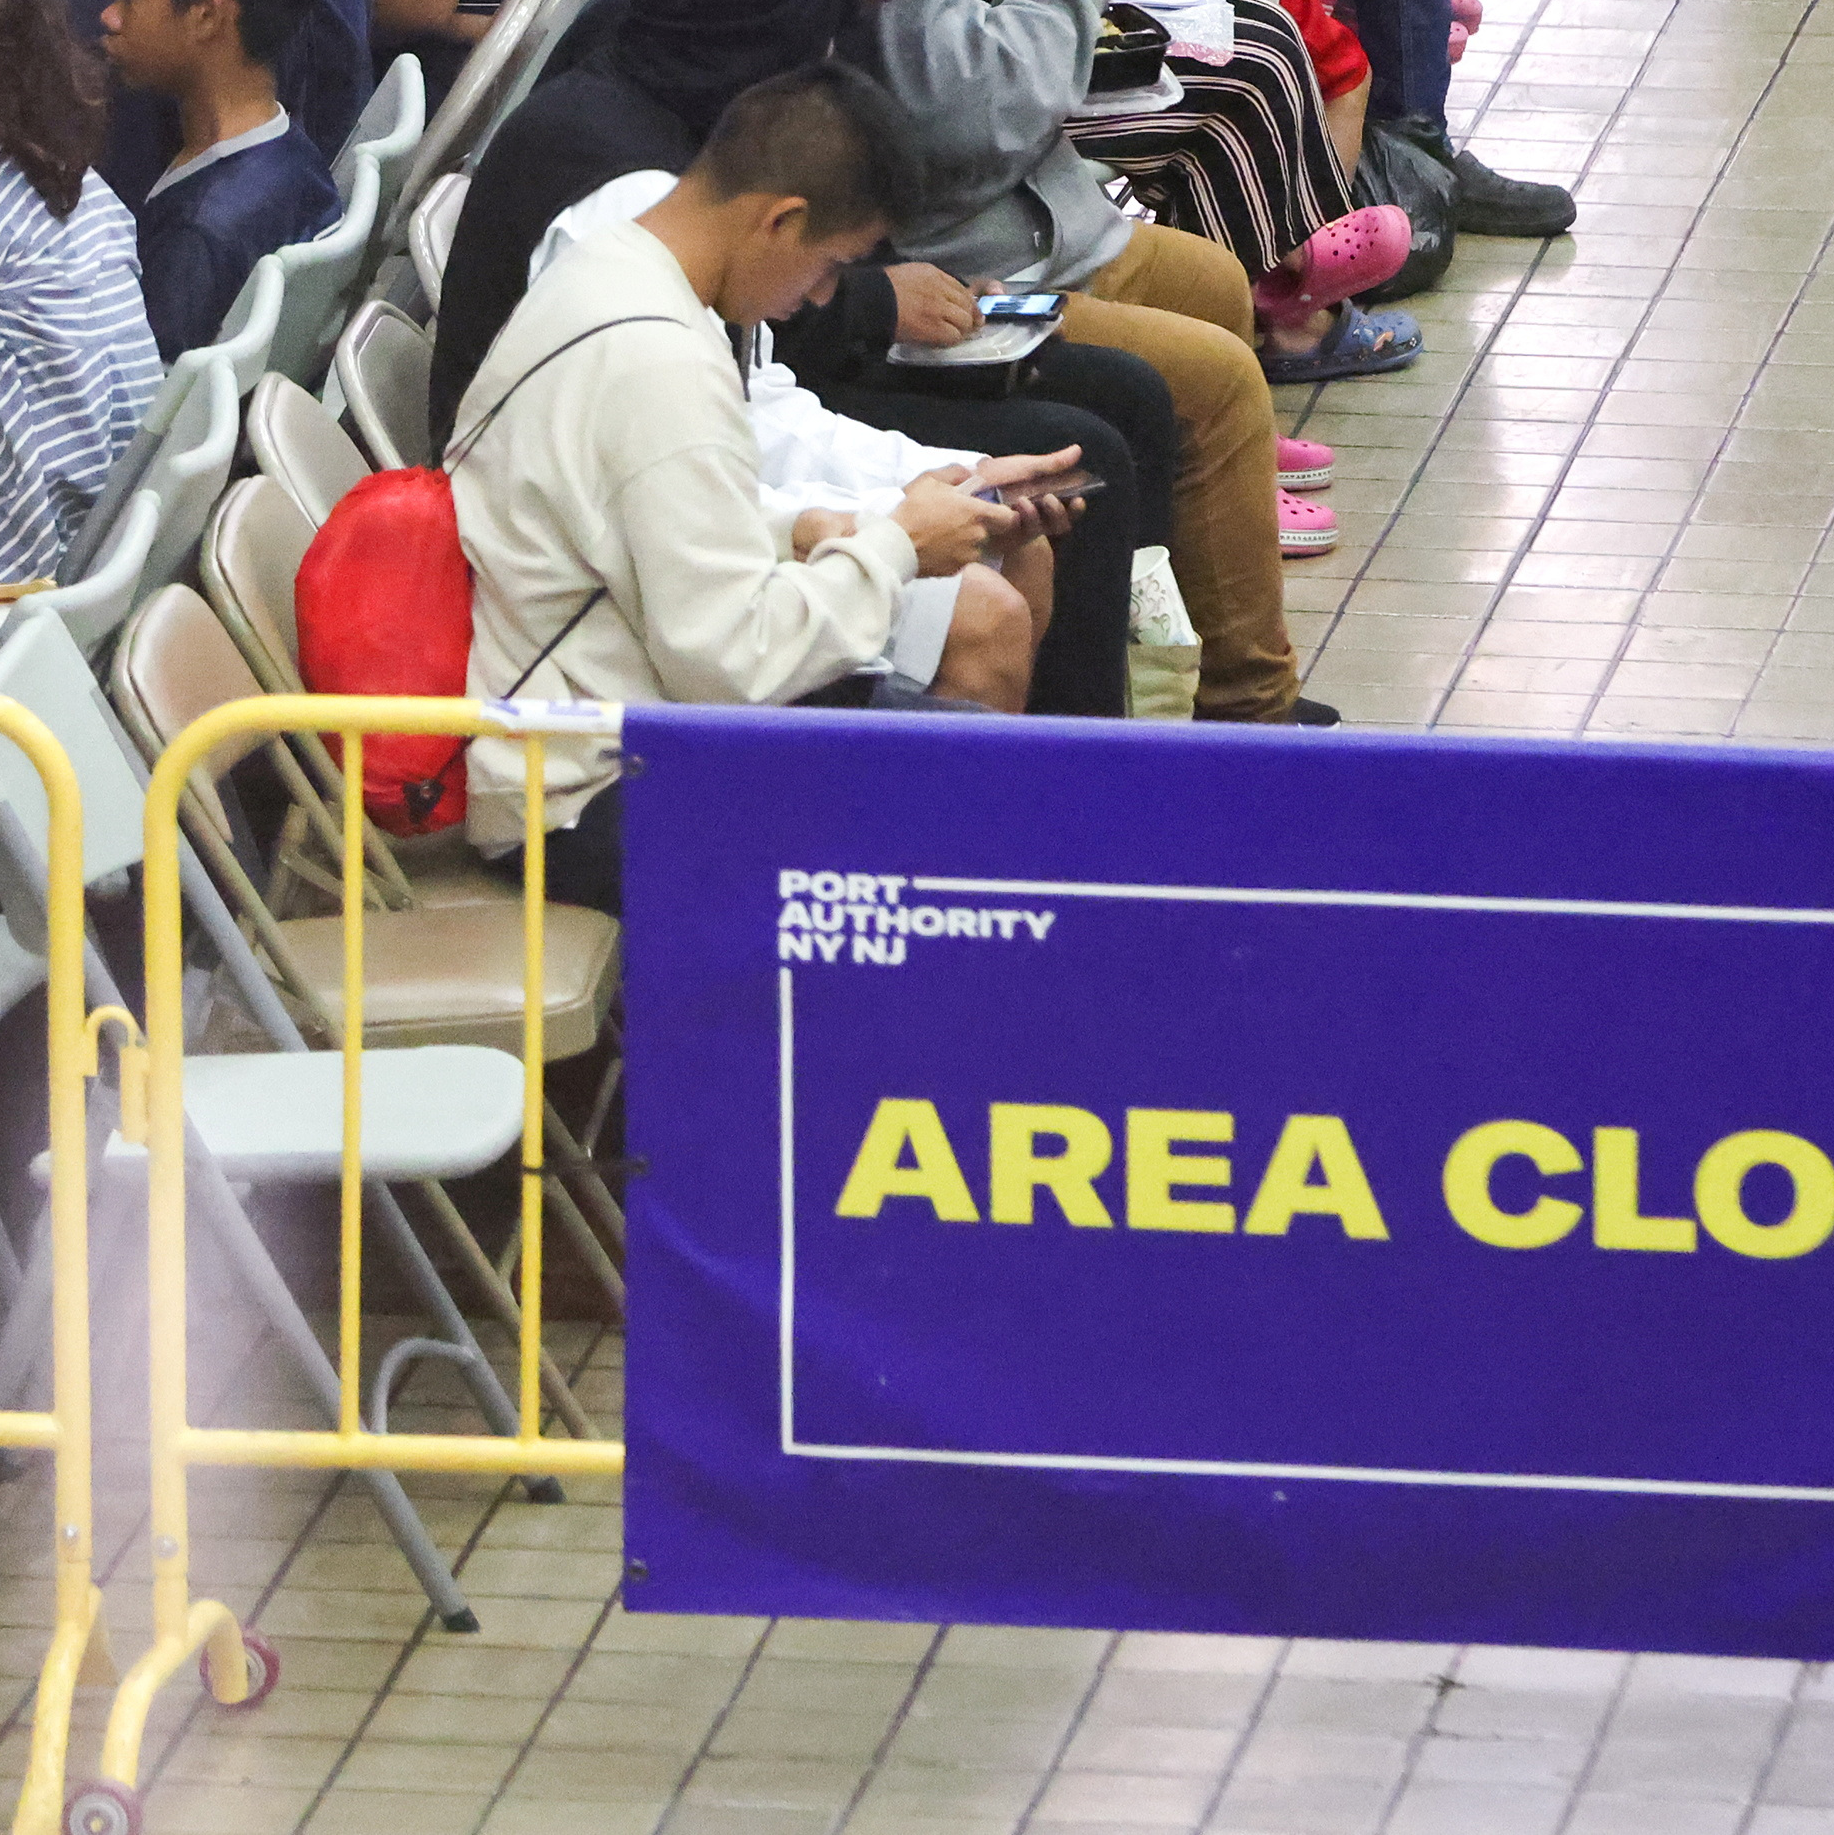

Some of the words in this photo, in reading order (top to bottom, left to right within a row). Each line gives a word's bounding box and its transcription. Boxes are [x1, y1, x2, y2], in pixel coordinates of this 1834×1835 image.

[778, 869, 908, 904] PORT
[777, 900, 1056, 940] AUTHORITY
[777, 932, 846, 963] NY
[852, 935, 907, 965] NJ
[834, 1097, 1390, 1242] AREA
